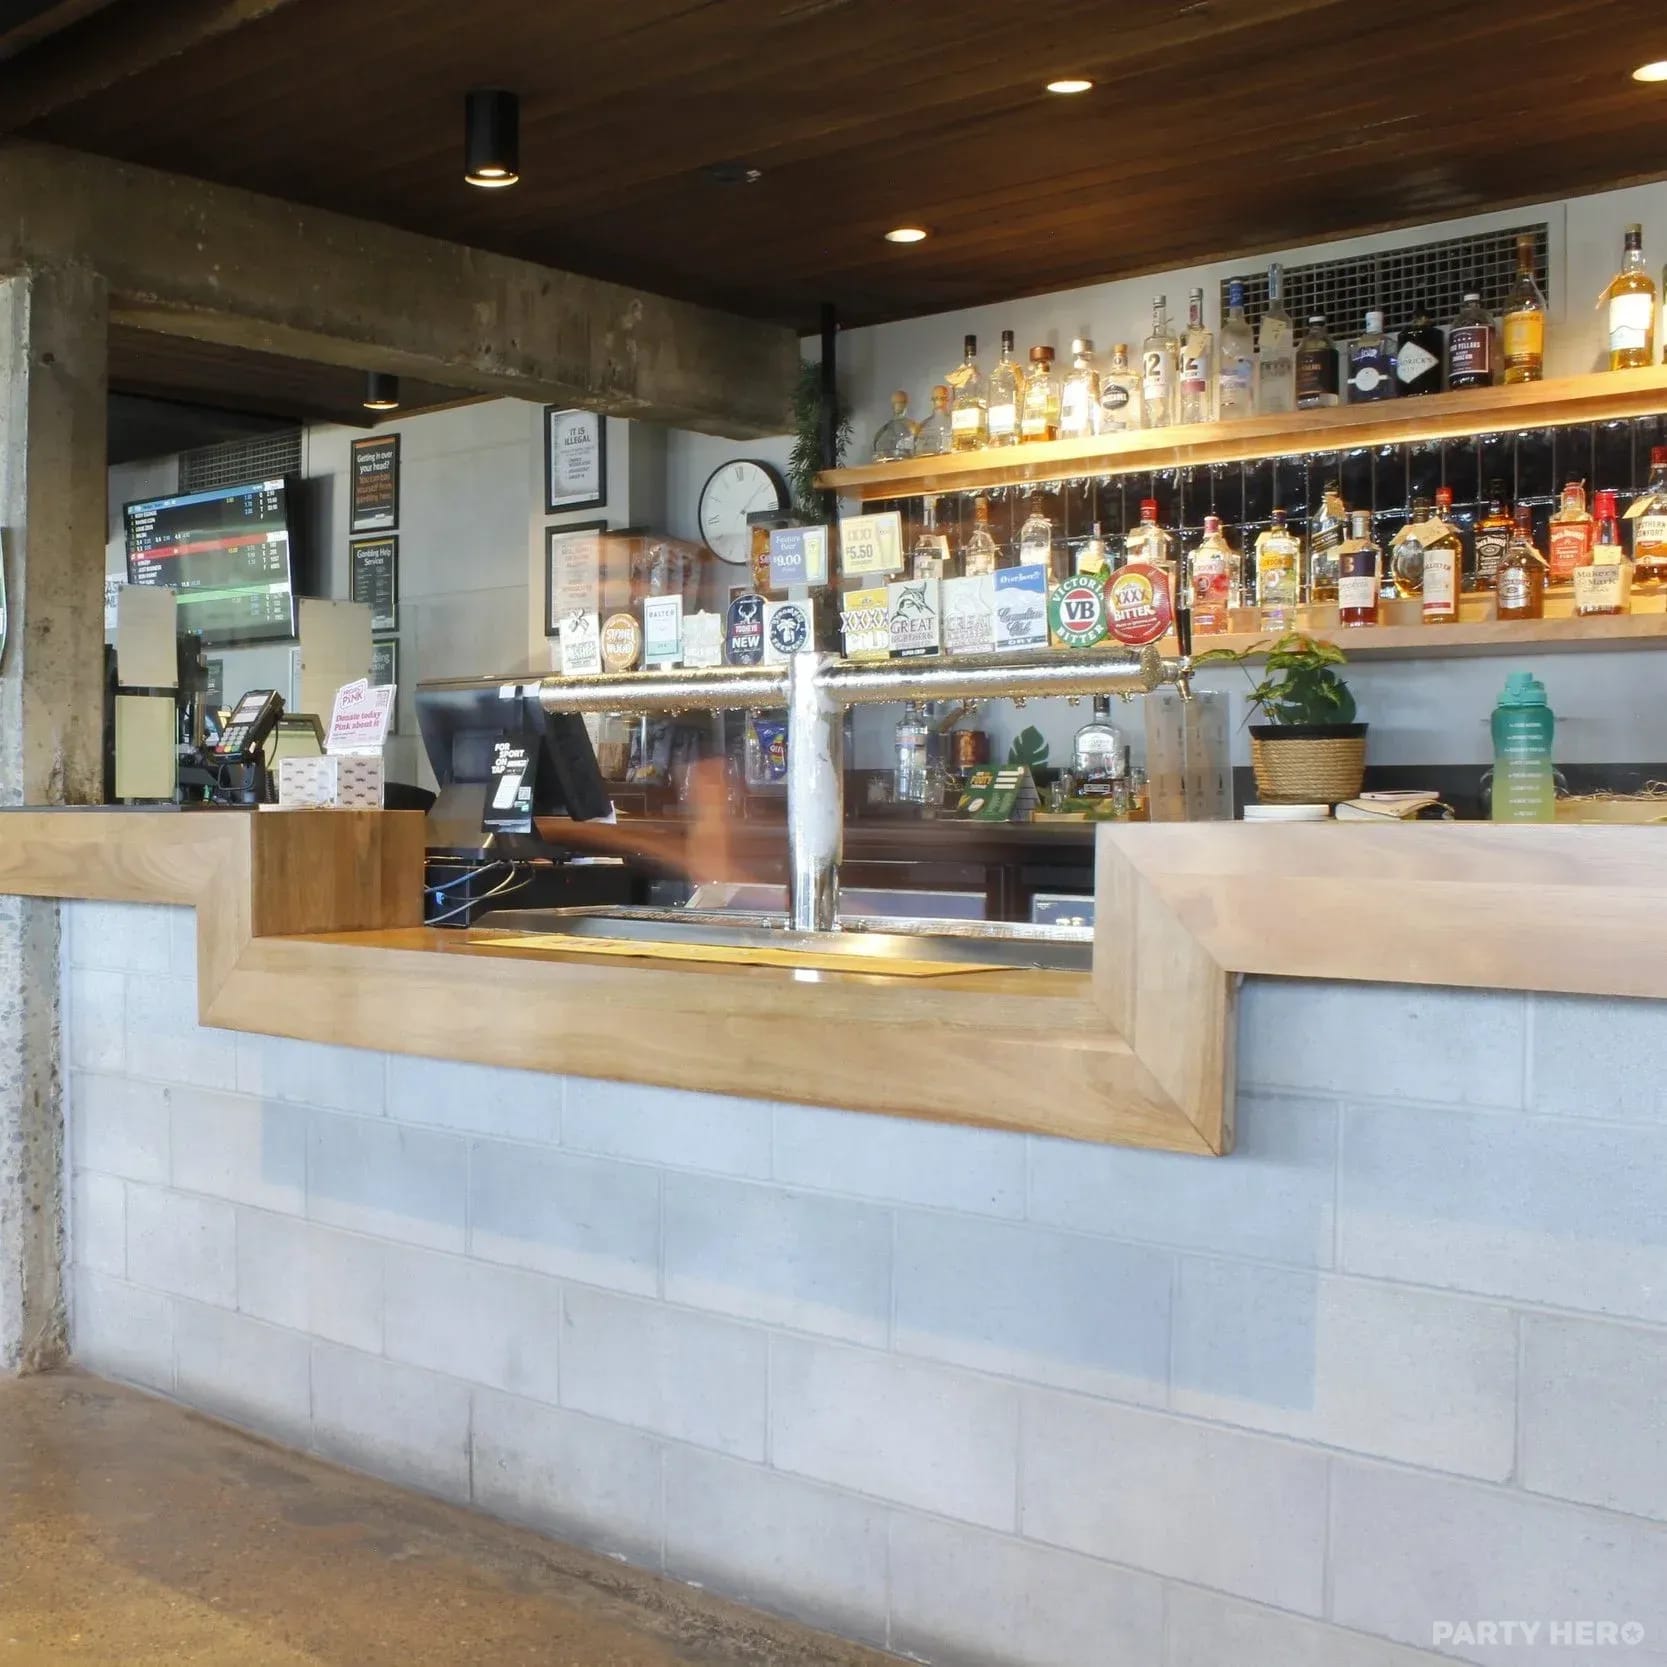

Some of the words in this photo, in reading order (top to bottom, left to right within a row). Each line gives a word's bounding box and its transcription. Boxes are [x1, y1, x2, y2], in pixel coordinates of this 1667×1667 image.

[564, 435, 591, 446] ILLEGAL
[773, 554, 802, 567] $9.00
[1052, 577, 1105, 602] VICTORIA
[1115, 588, 1150, 605] XXXX
[1064, 600, 1095, 620] VB
[1113, 604, 1156, 622] BITTER
[840, 607, 889, 633] XXXX
[890, 617, 935, 634] GREAT
[1056, 624, 1104, 643] BITTER
[731, 635, 760, 649] NEW
[336, 714, 360, 722] Donate
[361, 711, 383, 720] today
[335, 723, 350, 731] Pink
[352, 720, 373, 730] about
[494, 742, 511, 752] FOR
[499, 749, 526, 759] SPORT
[495, 758, 508, 767] ON
[491, 765, 506, 775] TAP
